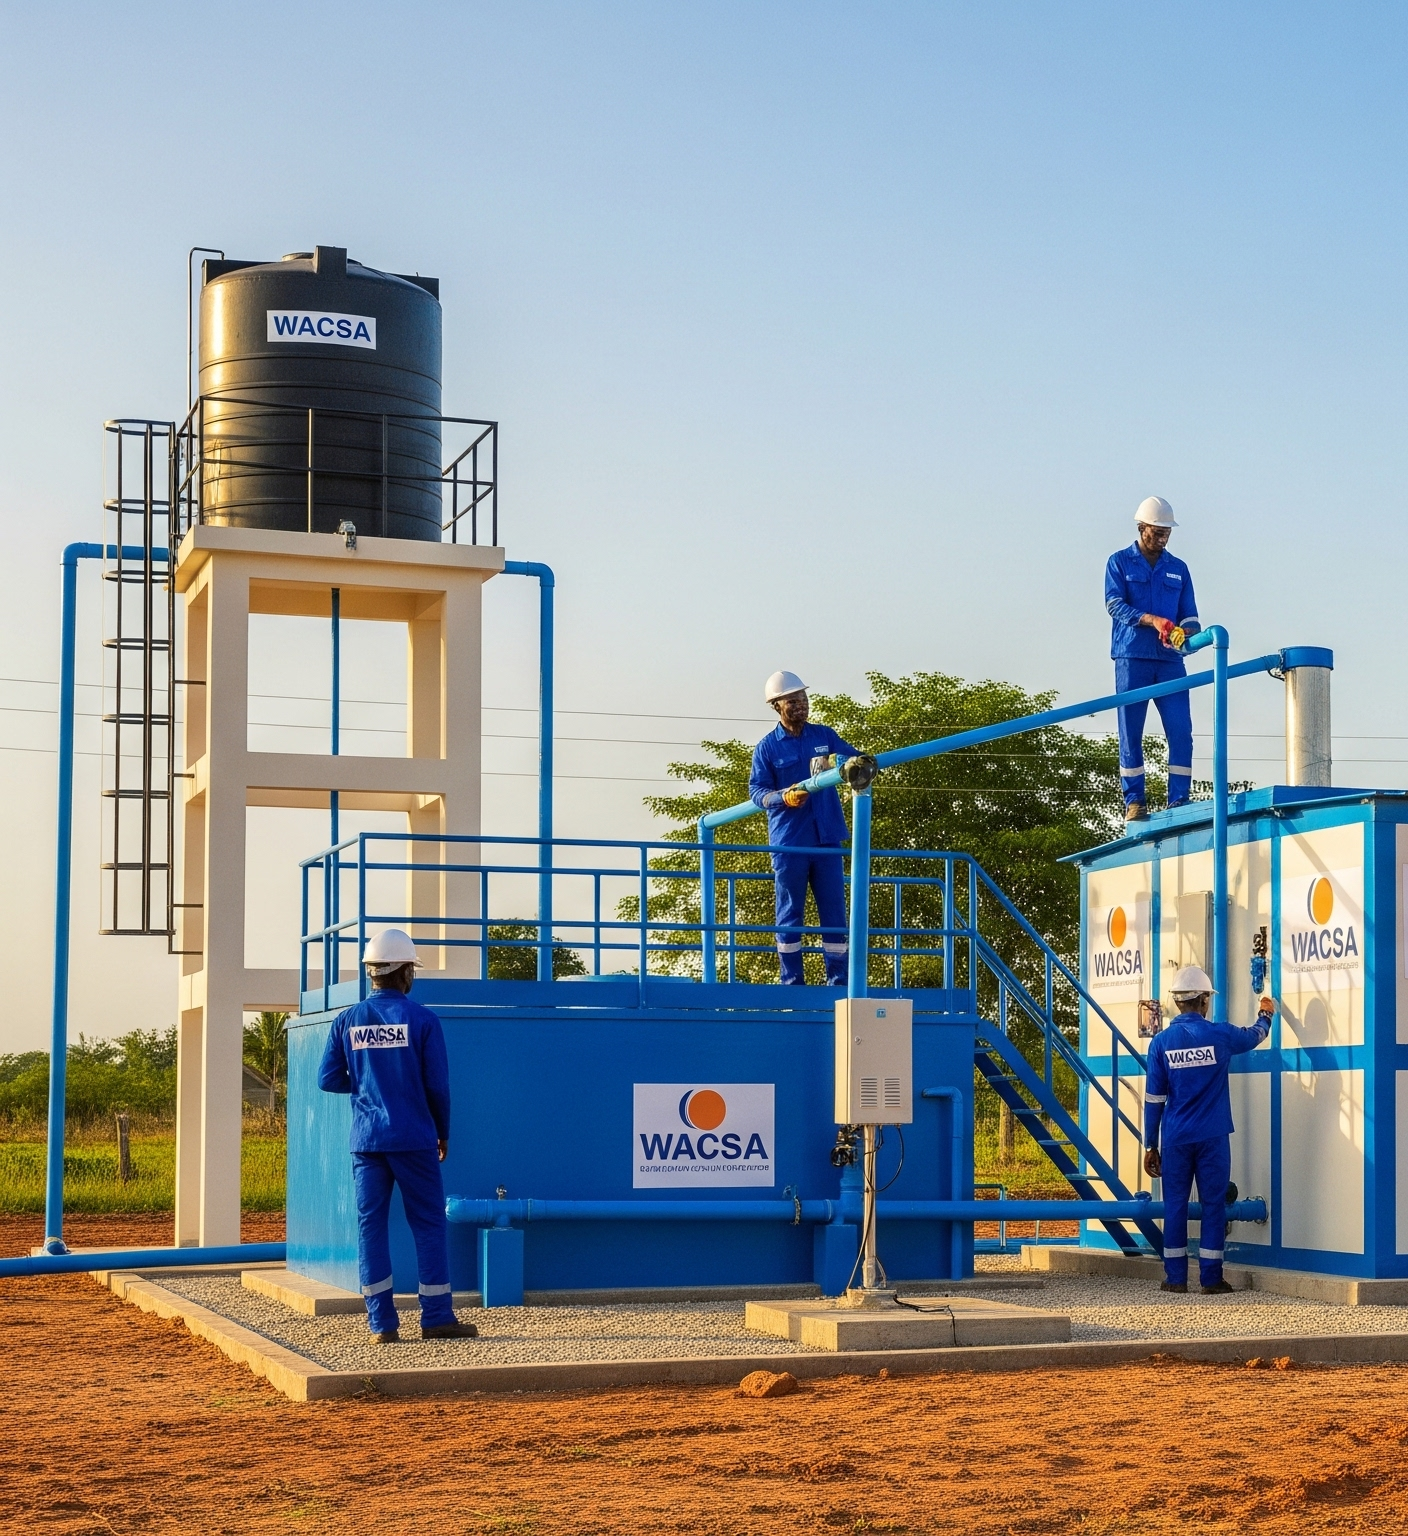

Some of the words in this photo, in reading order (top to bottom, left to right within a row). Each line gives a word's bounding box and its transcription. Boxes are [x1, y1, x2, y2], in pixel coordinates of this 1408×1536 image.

[274, 315, 372, 343] WACSA
[1291, 926, 1359, 963] WACSA
[1094, 949, 1143, 977] WACSA
[639, 1132, 769, 1161] WACSA
